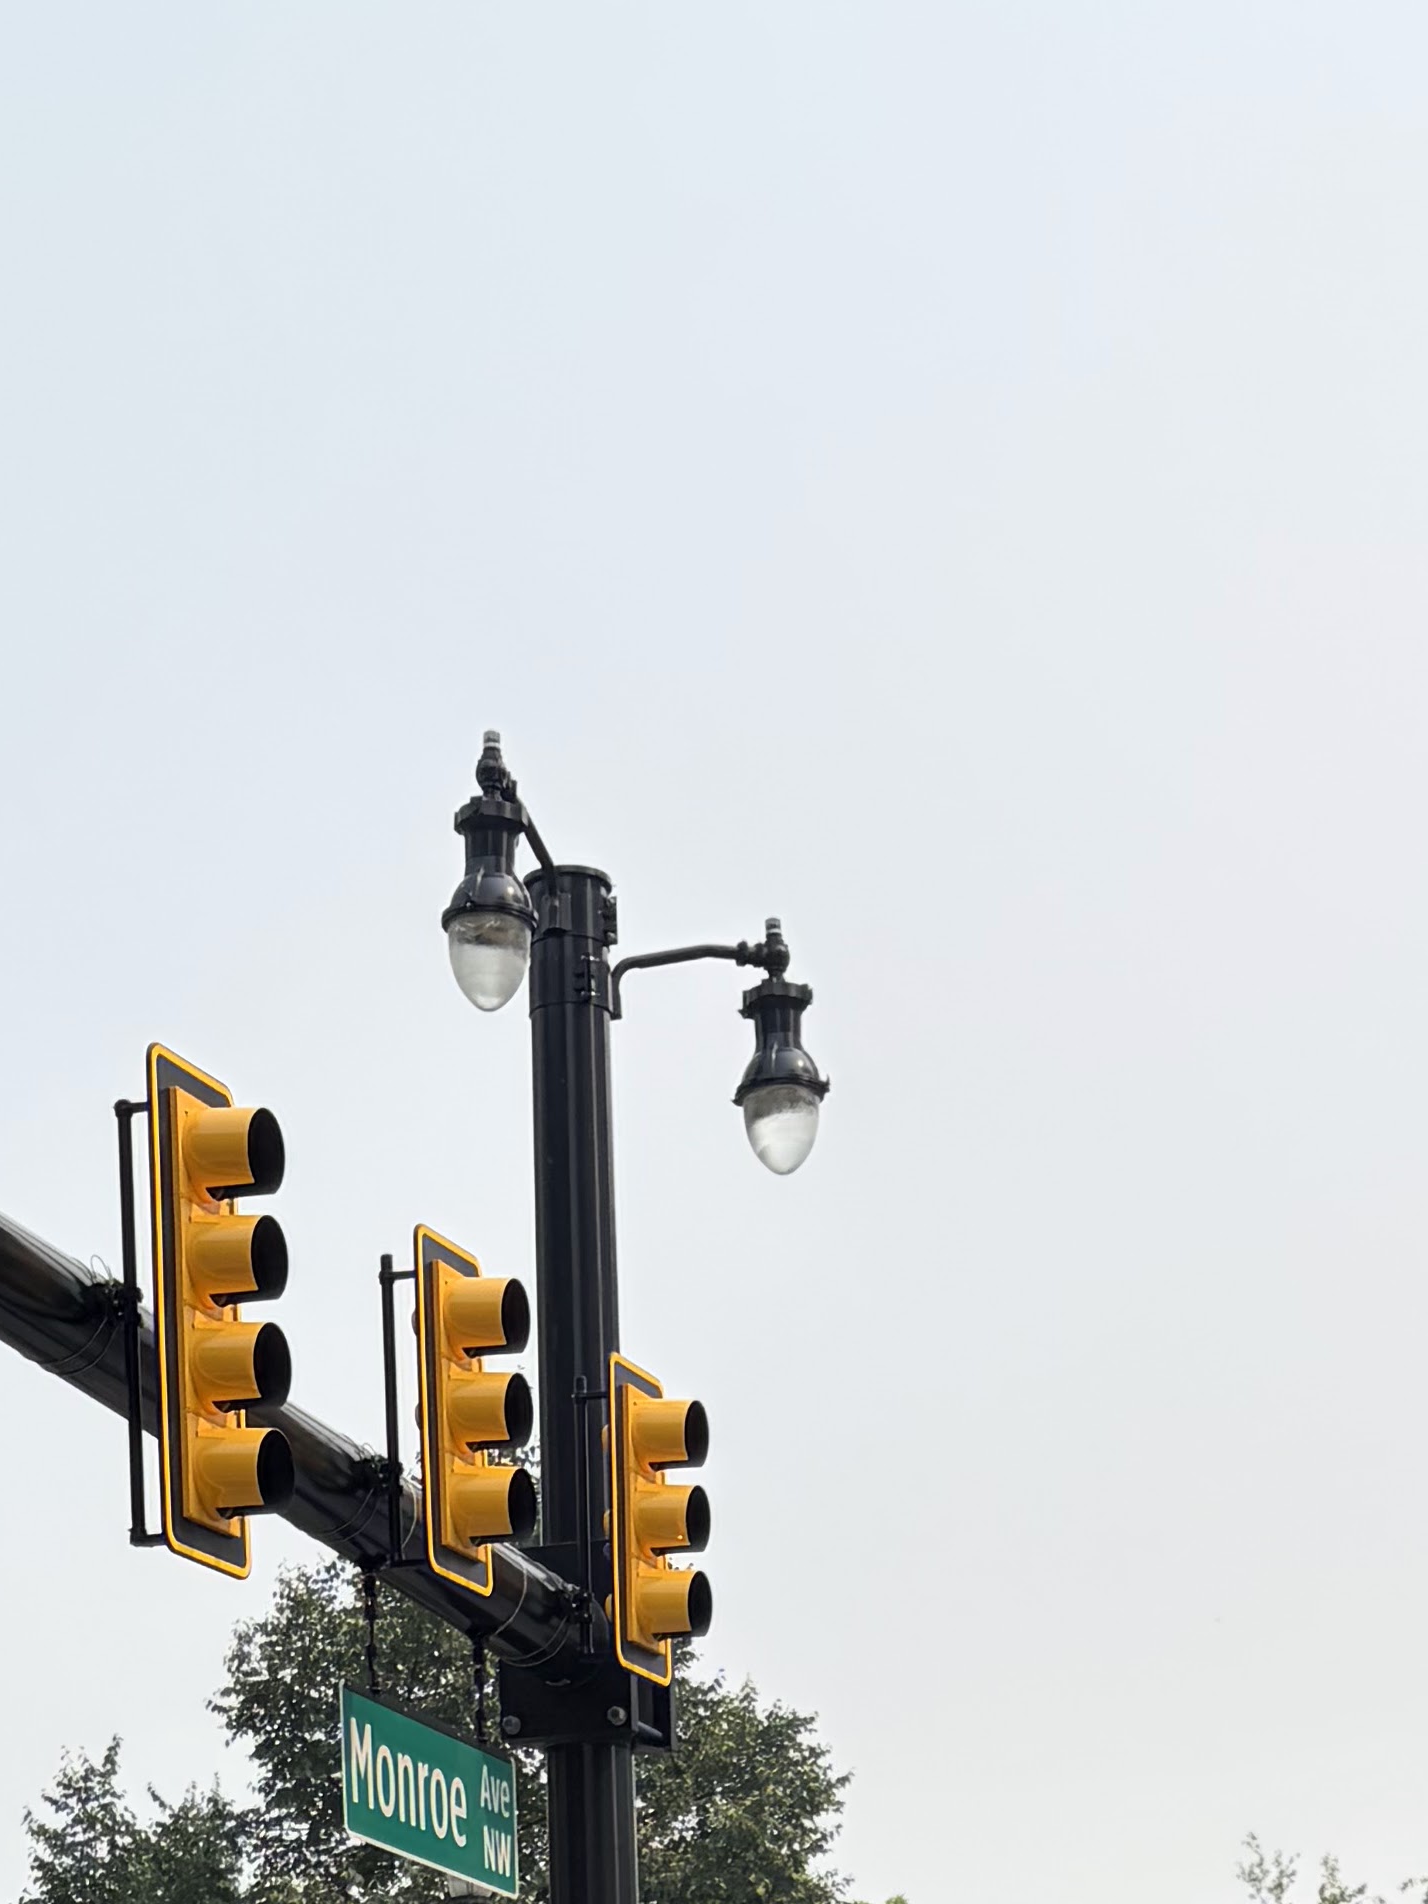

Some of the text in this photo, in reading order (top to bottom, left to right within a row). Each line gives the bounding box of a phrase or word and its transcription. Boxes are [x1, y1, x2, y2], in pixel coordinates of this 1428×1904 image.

[350, 1716, 511, 1849] Monroe Ave
[483, 1825, 513, 1878] NW
